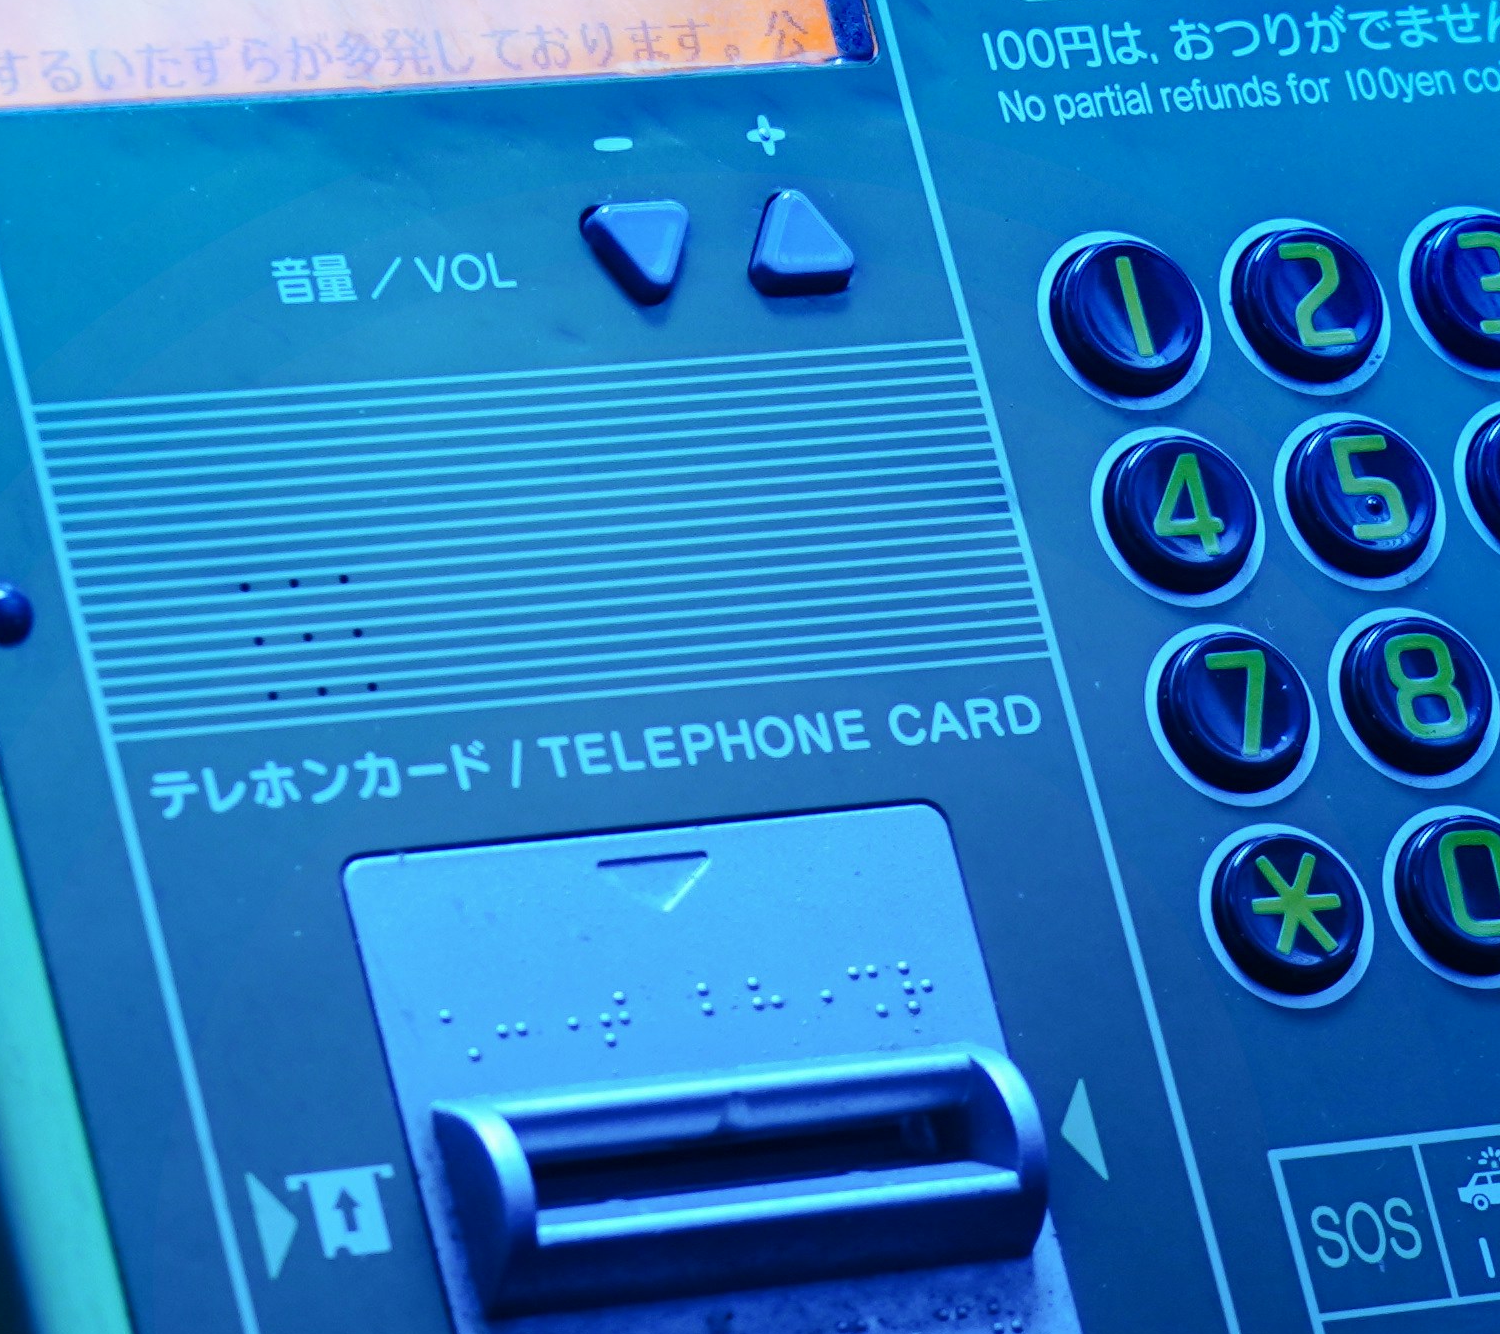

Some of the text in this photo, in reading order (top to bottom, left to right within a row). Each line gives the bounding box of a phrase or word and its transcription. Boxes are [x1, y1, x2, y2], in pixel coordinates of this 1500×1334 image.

[998, 89, 1048, 124] No
[1053, 82, 1155, 126] partial
[1159, 75, 1283, 114] refunds
[1285, 72, 1332, 105] for
[1344, 67, 1458, 104] 100yen
[413, 252, 518, 293] VOL
[1117, 257, 1153, 356] 1
[1280, 243, 1357, 346] 2
[1155, 453, 1224, 555] 4
[1332, 435, 1408, 539] 5
[1206, 649, 1265, 755] 7
[1385, 634, 1466, 738] 8
[149, 740, 491, 819] テレホンカード
[537, 708, 872, 779] TELEPHONE
[887, 694, 1042, 748] CARD
[1310, 1197, 1423, 1269] SOS
